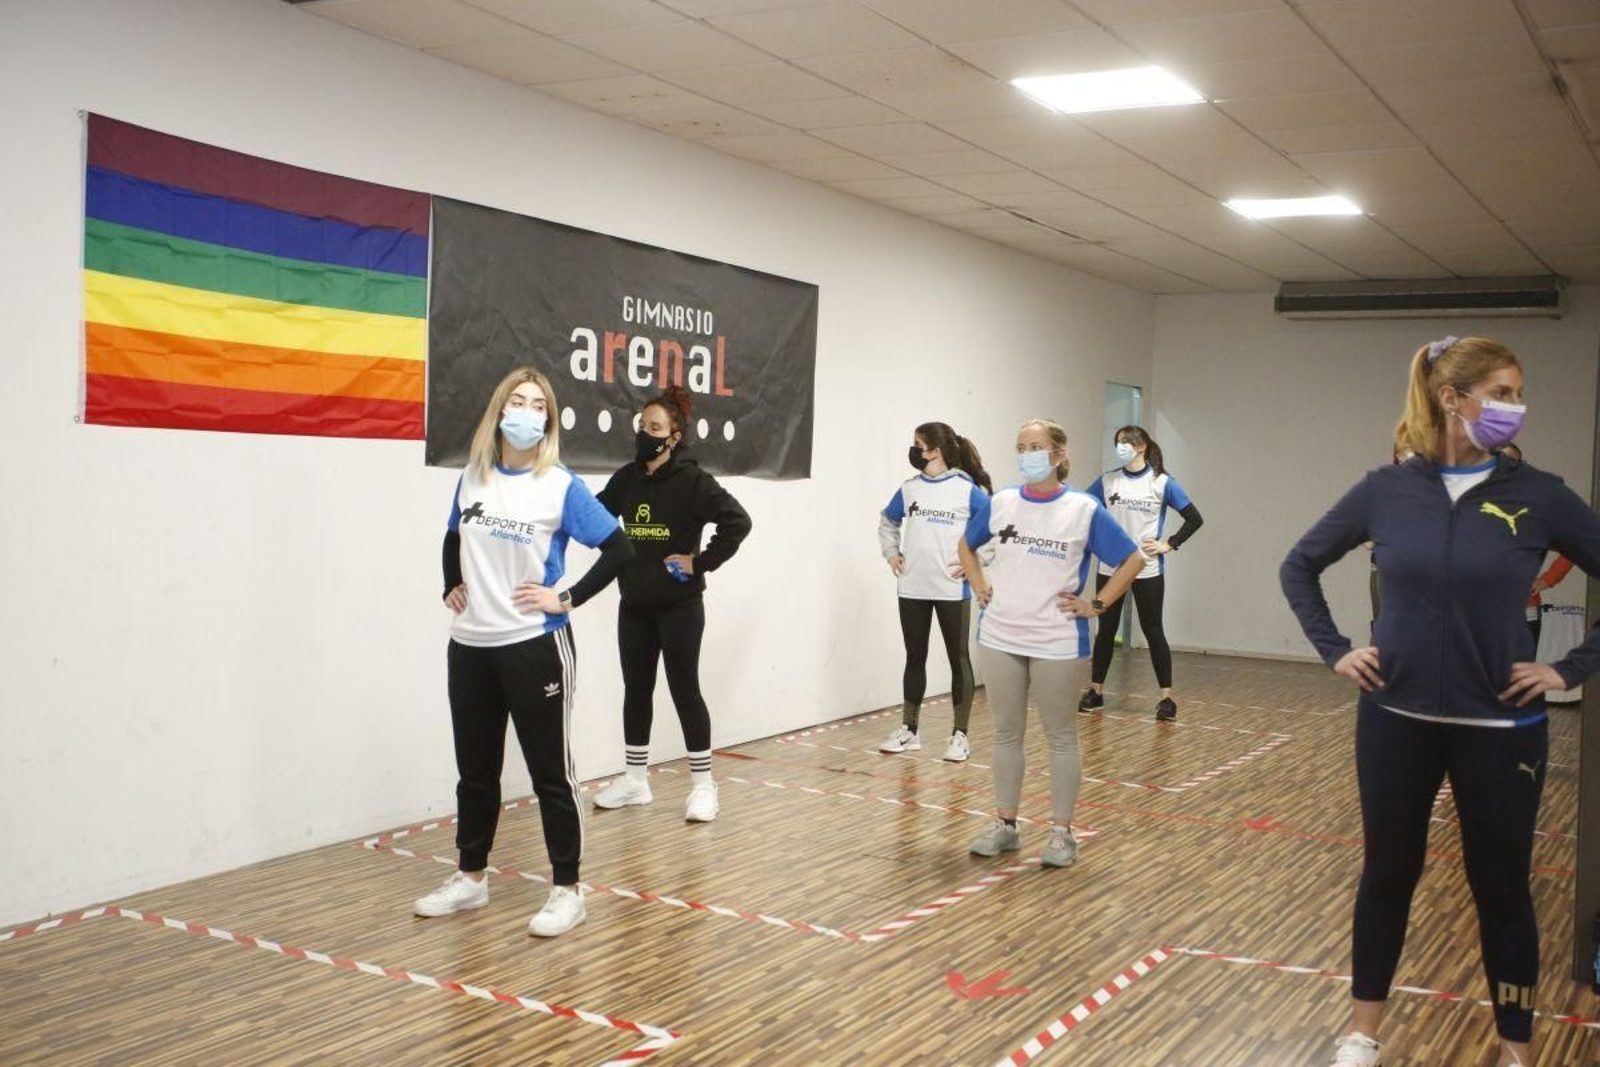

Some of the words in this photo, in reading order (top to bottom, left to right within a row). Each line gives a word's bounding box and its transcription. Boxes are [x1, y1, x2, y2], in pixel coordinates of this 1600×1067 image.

[623, 295, 713, 335] GIMNASIO
[916, 508, 957, 520] DEPORTE
[476, 515, 535, 535] DEPORTE
[1012, 535, 1068, 552] DEPORTE
